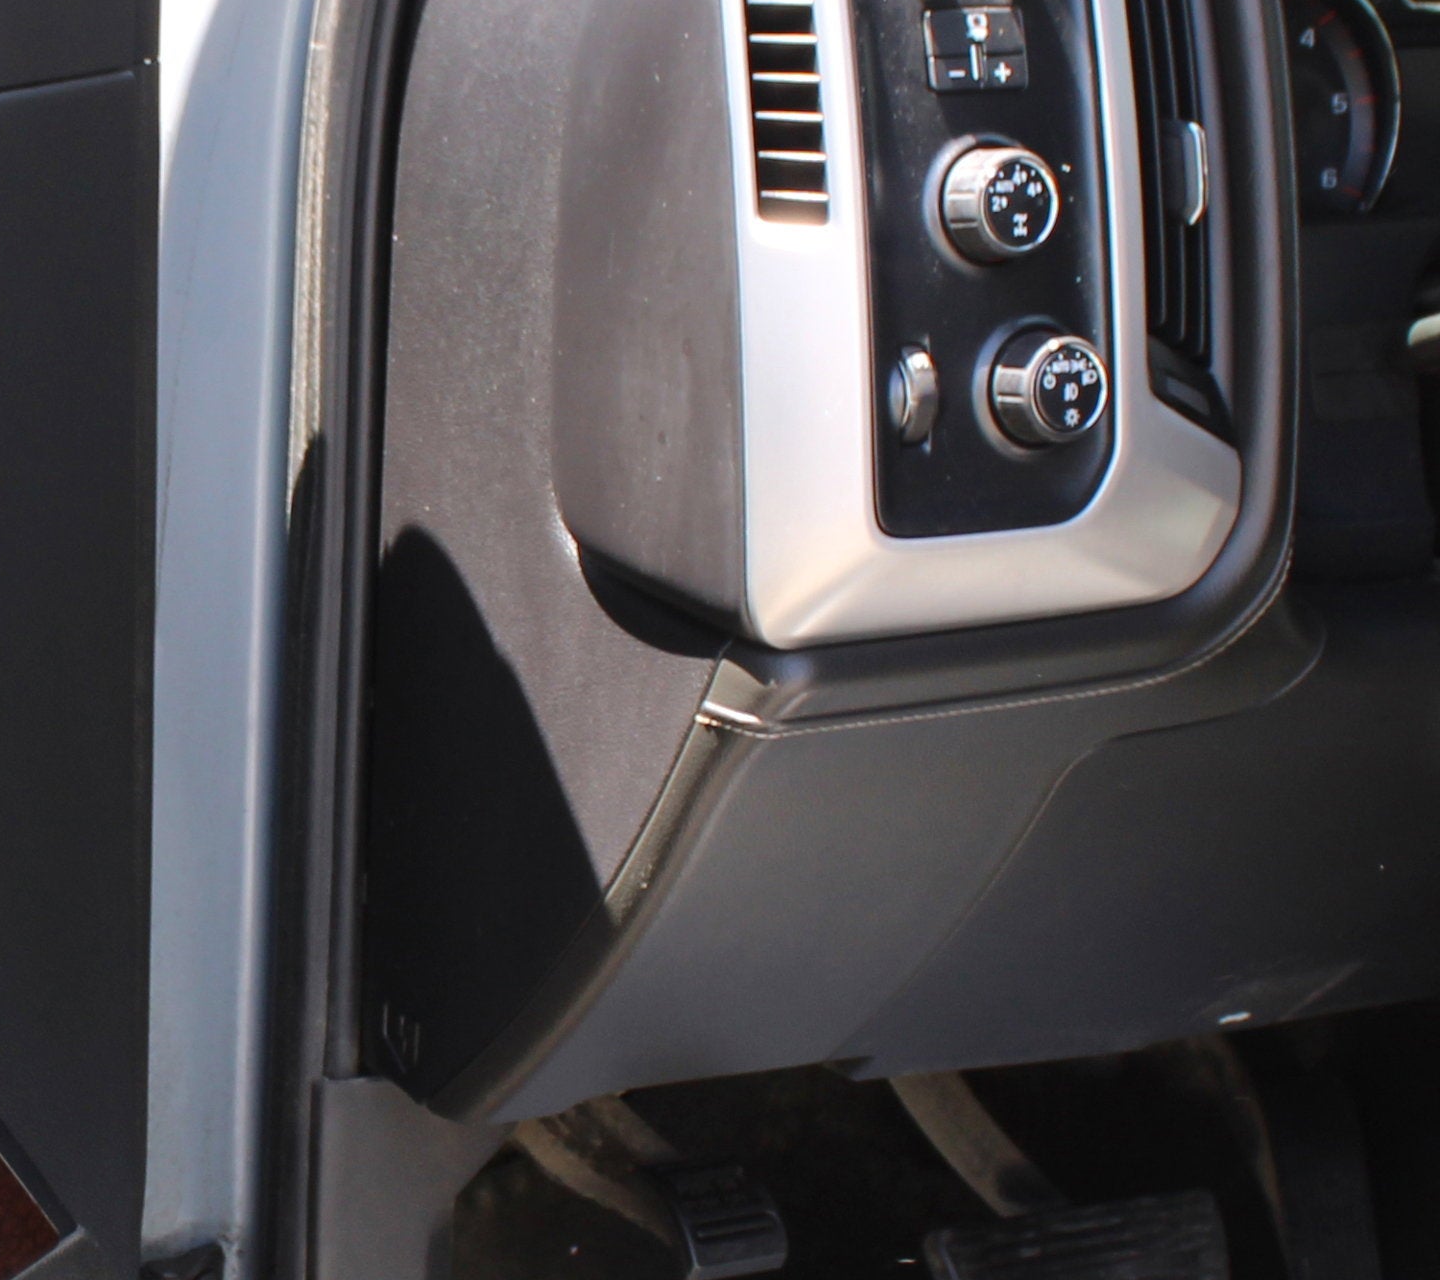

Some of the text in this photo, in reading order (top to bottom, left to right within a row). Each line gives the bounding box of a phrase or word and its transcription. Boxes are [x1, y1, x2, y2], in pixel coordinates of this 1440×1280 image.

[1298, 27, 1316, 49] 4
[1330, 92, 1348, 115] 5
[1320, 166, 1338, 190] 6
